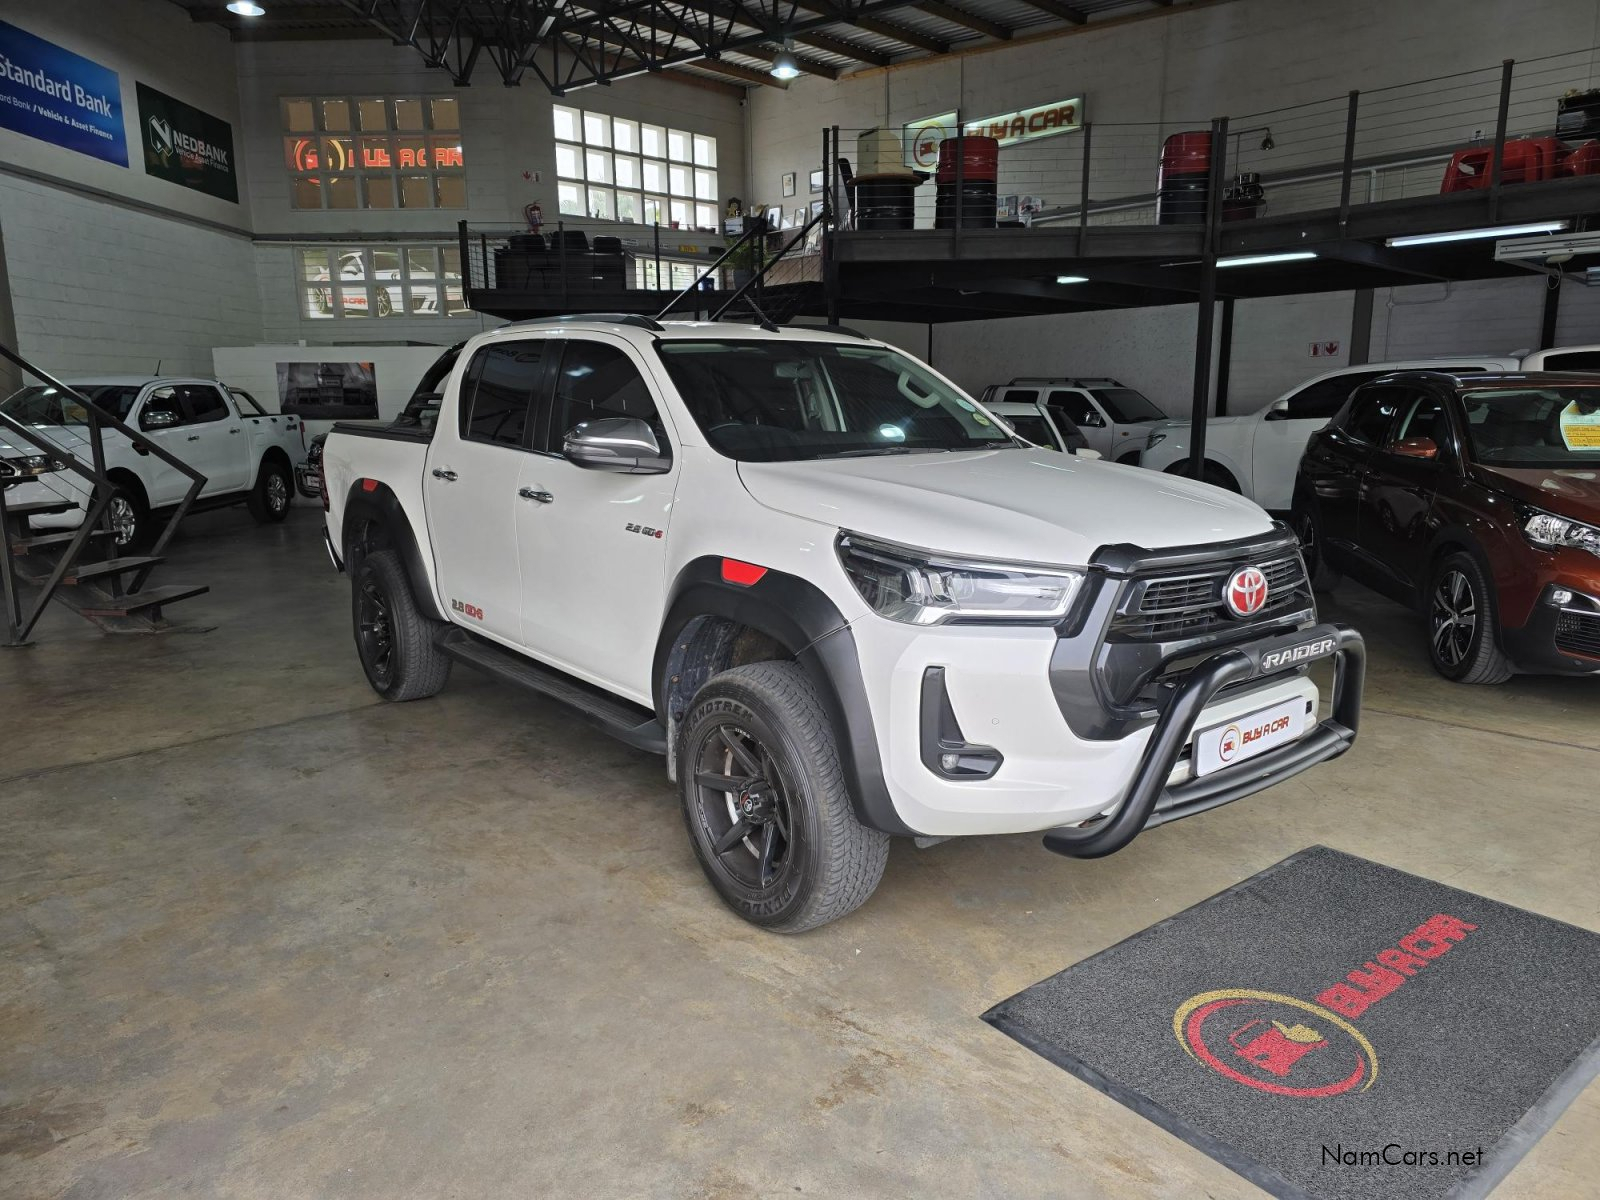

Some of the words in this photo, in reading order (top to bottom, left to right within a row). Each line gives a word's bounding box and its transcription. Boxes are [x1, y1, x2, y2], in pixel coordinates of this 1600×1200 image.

[74, 84, 113, 118] Bank
[13, 96, 32, 111] Bank
[37, 106, 63, 124] Vehicle
[64, 115, 70, 125] &
[71, 118, 89, 132] Asset
[89, 125, 114, 141] Finance
[1010, 116, 1026, 137] A
[1028, 105, 1075, 132] CAR
[173, 129, 228, 165] NEDBANK
[1265, 639, 1333, 669] RAIDER
[1242, 729, 1263, 745] BUY
[1262, 723, 1270, 737] A
[1271, 716, 1290, 733] CAR
[1314, 961, 1406, 1020] BUY
[1398, 913, 1480, 960] CAR
